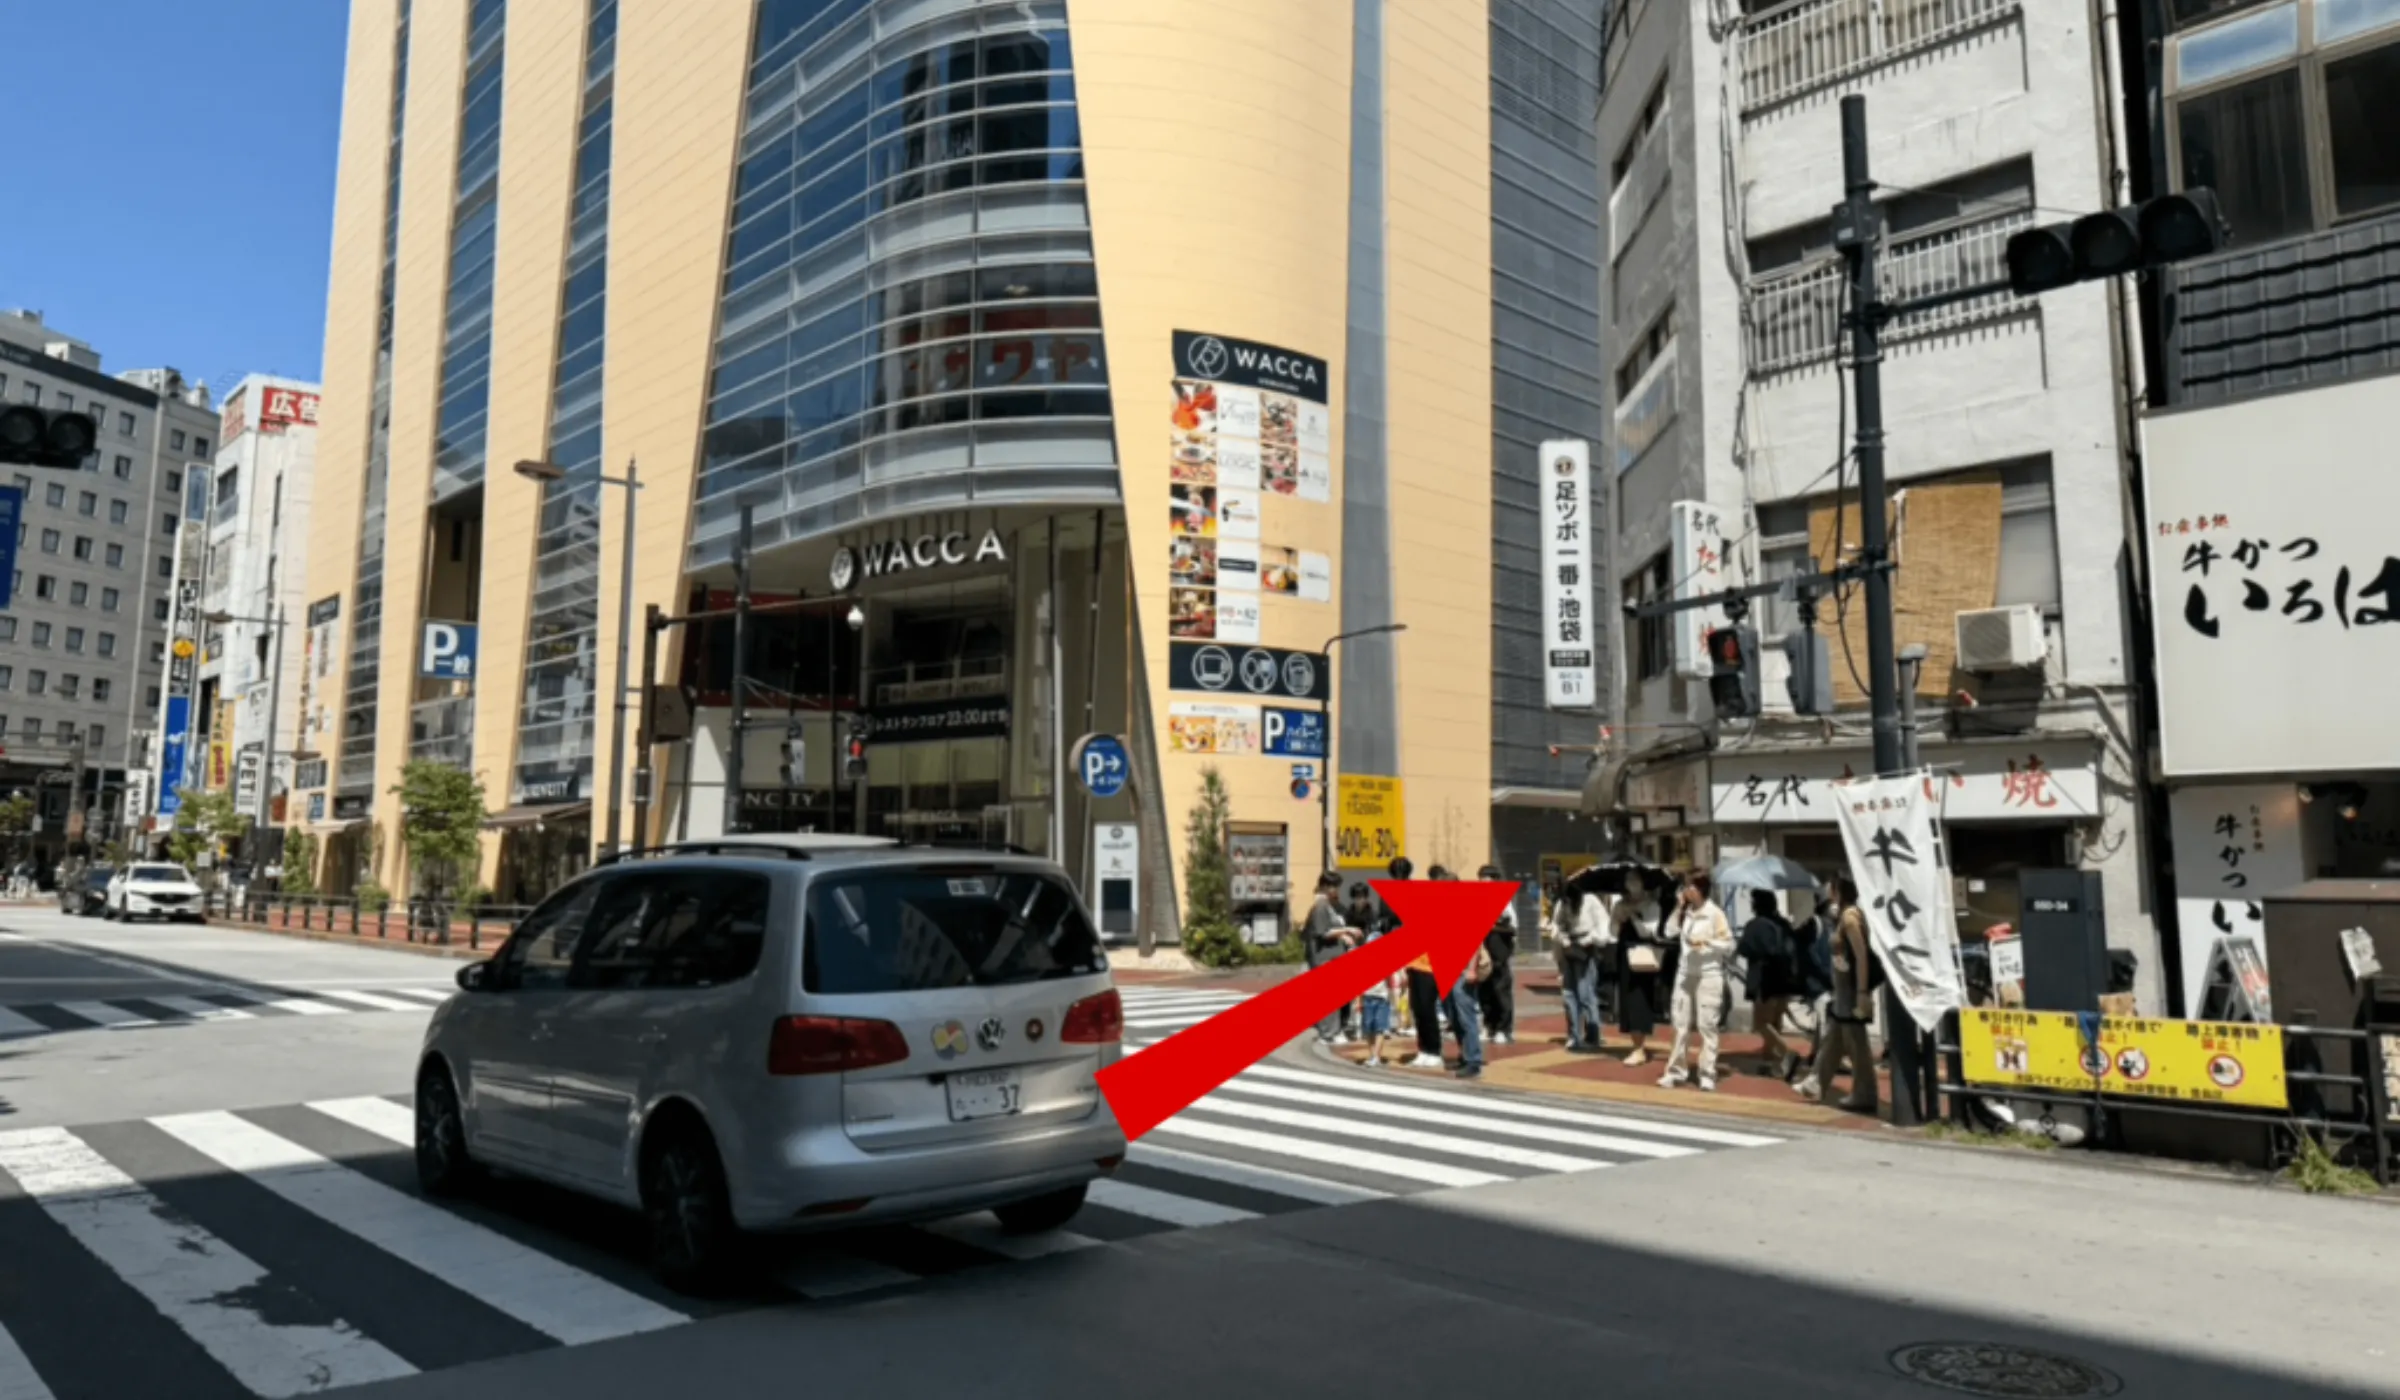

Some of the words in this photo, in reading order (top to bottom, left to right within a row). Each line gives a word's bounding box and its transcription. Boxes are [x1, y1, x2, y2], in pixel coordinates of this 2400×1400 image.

[1235, 347, 1317, 383] WACCA
[268, 392, 318, 421] 広告
[1692, 509, 1720, 536] 名代
[2158, 514, 2230, 536] お食事処
[863, 528, 1006, 577] WACCA
[1556, 481, 1581, 643] 足ツボ一番・池袋
[2182, 537, 2319, 578] 牛かつ
[2184, 555, 2400, 639] いろは
[424, 623, 458, 672] P
[1264, 711, 1285, 749] P
[1086, 752, 1104, 786] P
[1741, 773, 1809, 807] 名代
[2214, 814, 2248, 889] 牛かつ
